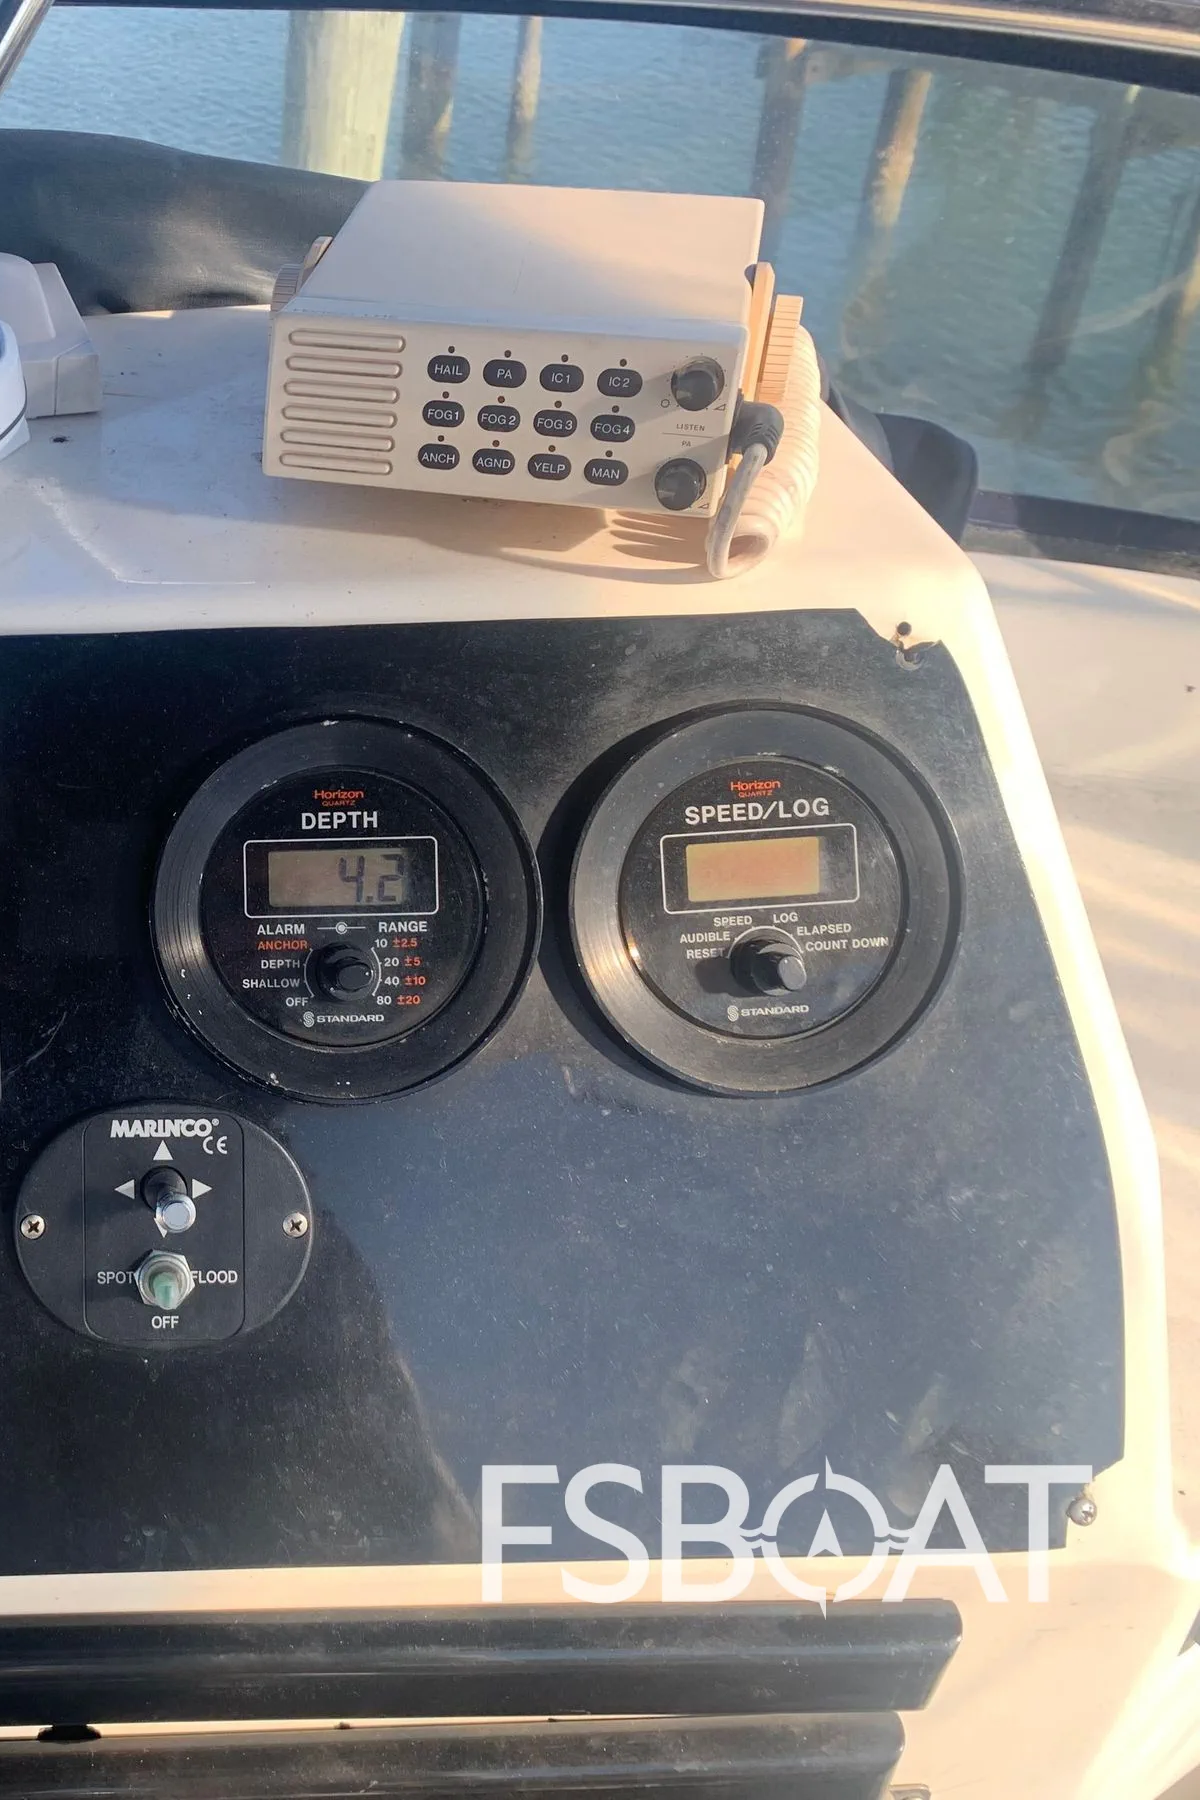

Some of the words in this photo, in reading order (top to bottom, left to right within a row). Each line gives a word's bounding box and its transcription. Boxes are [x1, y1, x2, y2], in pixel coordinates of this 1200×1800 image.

[434, 363, 463, 377] HAIL
[496, 368, 513, 380] PA
[676, 423, 706, 432] LISTEN
[681, 440, 692, 448] PA
[421, 452, 456, 465] ANCH
[476, 457, 511, 470] AGND
[534, 462, 566, 474] YELP
[591, 467, 620, 480] MAN
[730, 780, 781, 791] Horizon
[314, 789, 364, 800] Horizon
[738, 790, 773, 798] QUARTZ
[684, 797, 830, 825] SPEED/LOG
[301, 811, 378, 830] DEPTH
[338, 854, 406, 904] 4.2
[713, 915, 753, 927] SPEED
[773, 912, 799, 924] LOG
[256, 924, 305, 936] ALARM
[378, 921, 428, 933] RANGE
[796, 923, 852, 937] ELAPSED
[375, 939, 388, 948] 10
[679, 931, 731, 944] AUDIBLE
[257, 940, 308, 951] ANCHOR
[805, 939, 848, 952] COUNT
[852, 937, 889, 949] DOWN
[686, 948, 725, 960] RESET
[261, 959, 301, 969] DEPTH
[384, 957, 400, 967] 20
[242, 978, 301, 989] SHALLOW
[384, 976, 400, 987] 40
[285, 997, 309, 1007] OFF
[376, 996, 392, 1006] 80
[741, 1005, 810, 1016] STANDARD
[317, 1013, 385, 1023] STANDARD
[202, 1136, 228, 1155] CE
[97, 1271, 134, 1285] SPOT
[192, 1270, 238, 1284] FLOOD
[151, 1315, 179, 1329] OFF
